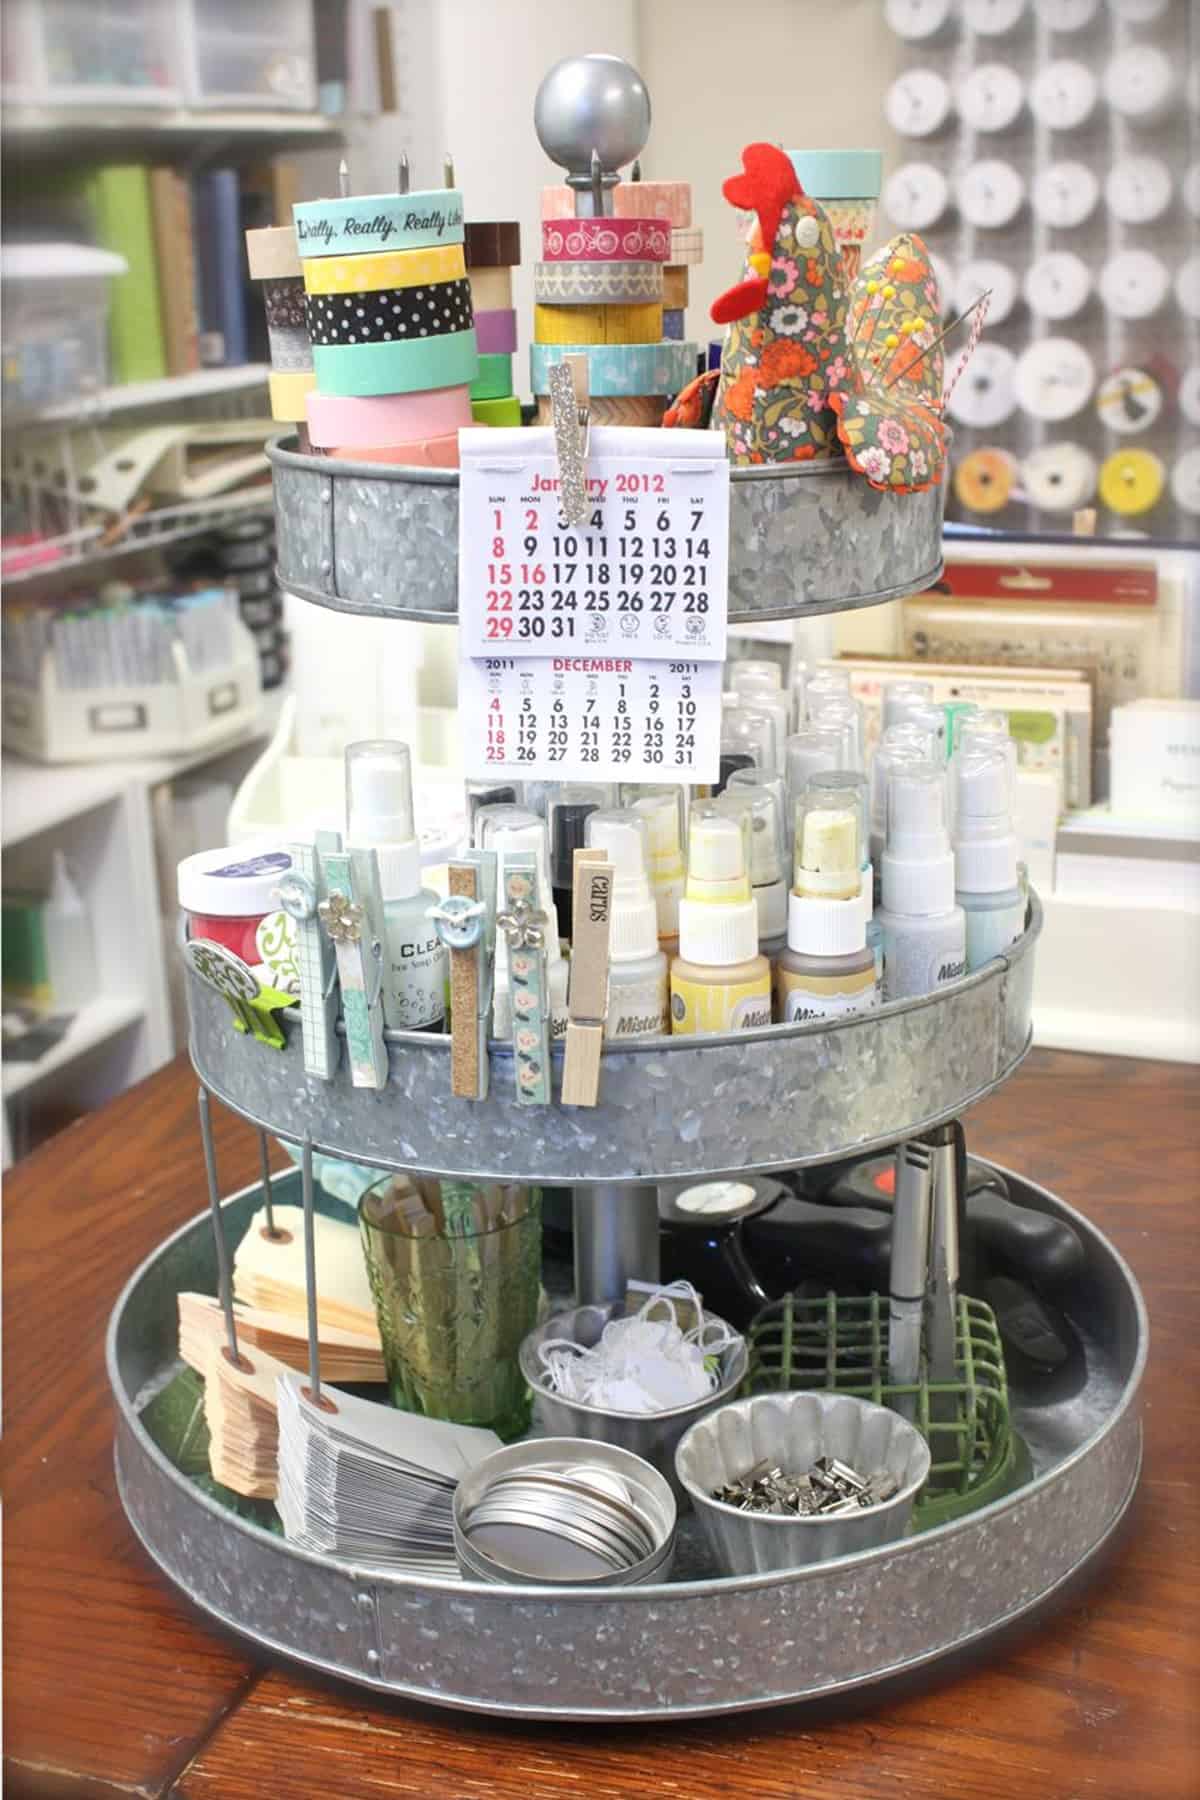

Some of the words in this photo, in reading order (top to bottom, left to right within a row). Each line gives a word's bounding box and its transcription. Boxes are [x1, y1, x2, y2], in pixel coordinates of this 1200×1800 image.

[402, 210, 445, 237] Really
[615, 474, 664, 493] 2012
[494, 509, 502, 531] 1
[525, 509, 538, 531] 2
[590, 508, 605, 531] 4
[623, 509, 637, 532] 5
[656, 510, 671, 532] 6
[690, 510, 704, 532] 7
[492, 536, 505, 558] 8
[523, 535, 538, 557] 9
[552, 535, 578, 558] 10
[584, 535, 608, 558] 11
[618, 536, 644, 558] 12
[652, 536, 677, 559] 13
[685, 537, 711, 559] 14
[487, 563, 512, 585] 15
[520, 563, 546, 585] 16
[552, 563, 578, 585] 17
[585, 562, 611, 585] 18
[618, 563, 644, 585] 19
[649, 563, 677, 587] 20
[682, 564, 707, 587] 21
[486, 590, 513, 612] 22
[517, 589, 545, 611] 23
[551, 589, 578, 611] 24
[583, 589, 611, 612] 25
[616, 590, 644, 613] 26
[649, 590, 677, 613] 27
[682, 591, 709, 614] 28
[486, 617, 513, 638] 29
[517, 616, 546, 638] 30
[551, 616, 575, 638] 31
[486, 659, 515, 670] 2011
[552, 659, 632, 672] DECEMBER
[669, 663, 698, 673] 2011
[649, 683, 660, 699] 2
[681, 684, 691, 699] 3
[490, 697, 500, 711] 4
[522, 697, 532, 712] 5
[553, 698, 564, 713] 6
[586, 698, 596, 713] 7
[617, 699, 627, 714] 8
[648, 700, 660, 714] 9
[677, 701, 697, 716] 10
[488, 714, 503, 727] 11
[519, 713, 537, 728] 12
[550, 714, 568, 729] 13
[582, 715, 601, 729] 14
[614, 715, 632, 731] 15
[645, 716, 665, 731] 16
[677, 717, 696, 732] 17
[488, 730, 505, 744] 18
[519, 730, 537, 744] 19
[548, 730, 568, 745] 20
[580, 731, 598, 746] 21
[612, 732, 632, 747] 22
[643, 732, 664, 748] 23
[675, 733, 696, 748] 24
[486, 746, 505, 760] 25
[517, 746, 537, 761] 26
[548, 747, 567, 761] 27
[580, 747, 600, 762] 28
[611, 748, 632, 763] 29
[643, 749, 664, 764] 30
[675, 750, 692, 765] 31
[401, 936, 441, 957] CLEA
[937, 961, 963, 981] Mist
